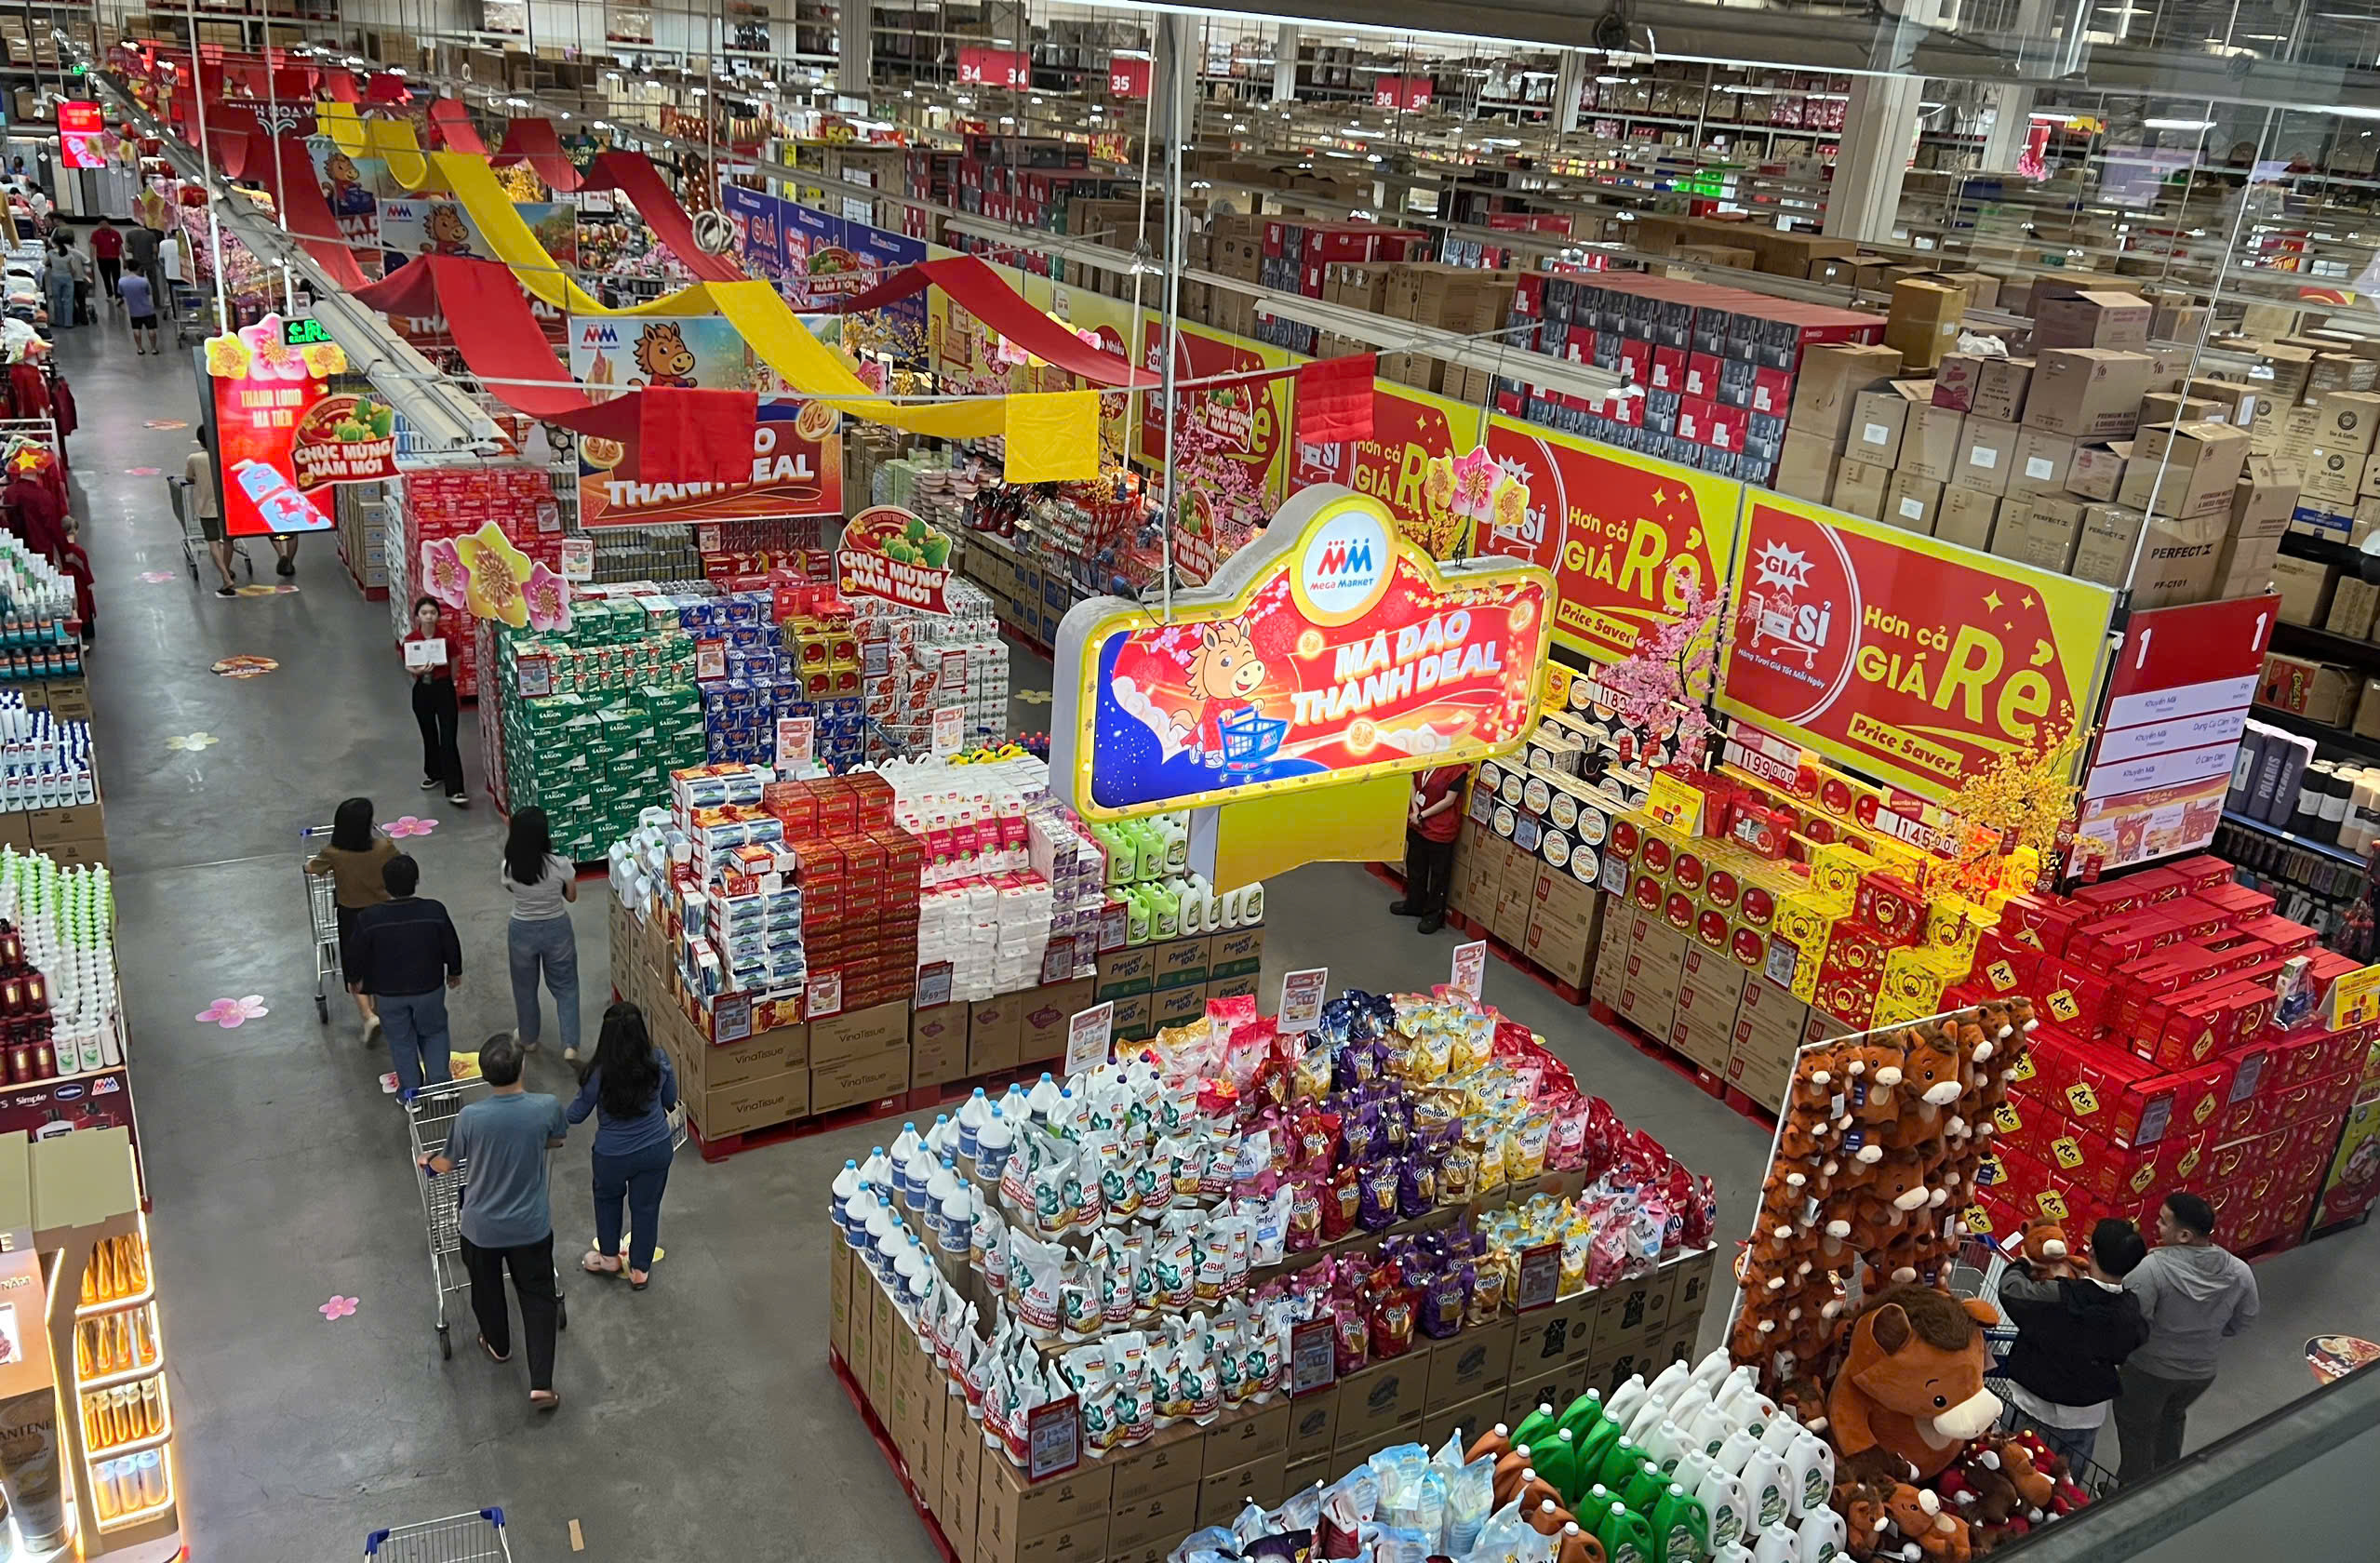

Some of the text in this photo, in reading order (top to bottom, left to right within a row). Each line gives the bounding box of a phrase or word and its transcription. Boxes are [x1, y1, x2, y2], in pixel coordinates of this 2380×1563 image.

[961, 65, 981, 82] 34
[1008, 68, 1026, 85] 34
[1112, 74, 1130, 91] 35
[1377, 91, 1393, 106] 36
[1384, 444, 1401, 464] cả
[731, 453, 815, 486] EAL
[1354, 465, 1393, 501] GIÁ
[1568, 505, 1629, 543] Hơn cả
[2033, 513, 2062, 527] PERFECT
[2150, 545, 2202, 559] PERFECT
[1563, 517, 1704, 614] GIÁ Rẻ
[1764, 551, 1802, 580] GIÁ
[1560, 603, 1638, 645] Price Saver
[1794, 600, 1832, 648] SỈ
[1863, 604, 1950, 653] Hơn cả
[2251, 611, 2267, 651] 1
[2135, 628, 2152, 670] 1
[1416, 639, 1503, 694] DEAL
[1854, 622, 2056, 742] GIÁ Rẻ
[656, 699, 677, 707] SAIGON
[539, 711, 562, 720] SAIGON
[660, 718, 681, 727] SAIGON
[609, 723, 632, 732] SAIGON
[592, 746, 614, 755] SAIGON
[1852, 717, 1958, 773] Price Saver
[540, 752, 562, 761] SAIGON
[663, 757, 685, 766] SAIGON
[613, 764, 635, 773] SAIGON
[2258, 755, 2280, 800] POLARIS
[544, 791, 567, 800] SAIGON
[595, 785, 618, 794] SAIGON
[614, 803, 635, 811] SAIGON
[1223, 934, 1253, 954] Power
[1235, 943, 1250, 955] 100
[1168, 944, 1200, 964] Power
[1181, 955, 1197, 966] 100
[1111, 955, 1143, 975] Power
[1123, 964, 1141, 977] 100
[1992, 967, 2012, 984] An
[1165, 990, 1195, 1010] Power
[1176, 1000, 1192, 1013] 100
[2052, 995, 2073, 1013] An
[1119, 1010, 1136, 1022] 100
[838, 1025, 887, 1043] VinaTissue
[735, 1048, 784, 1065] VinaTissue
[2014, 1057, 2029, 1074] An
[840, 1072, 887, 1089] VinaTissue
[16, 1093, 47, 1105] Simple
[736, 1094, 785, 1115] VinaTissue
[2071, 1089, 2093, 1108] An
[1418, 1104, 1449, 1118] Comfort
[1997, 1107, 2015, 1126] An
[1519, 1133, 1544, 1147] Comfort
[2057, 1142, 2077, 1161] An
[1443, 1156, 1473, 1169] Comfort
[2042, 1196, 2063, 1216] An
[1969, 1210, 1986, 1228] An
[1476, 1274, 1504, 1289] Comfort
[0, 1419, 52, 1439] ANTENE
